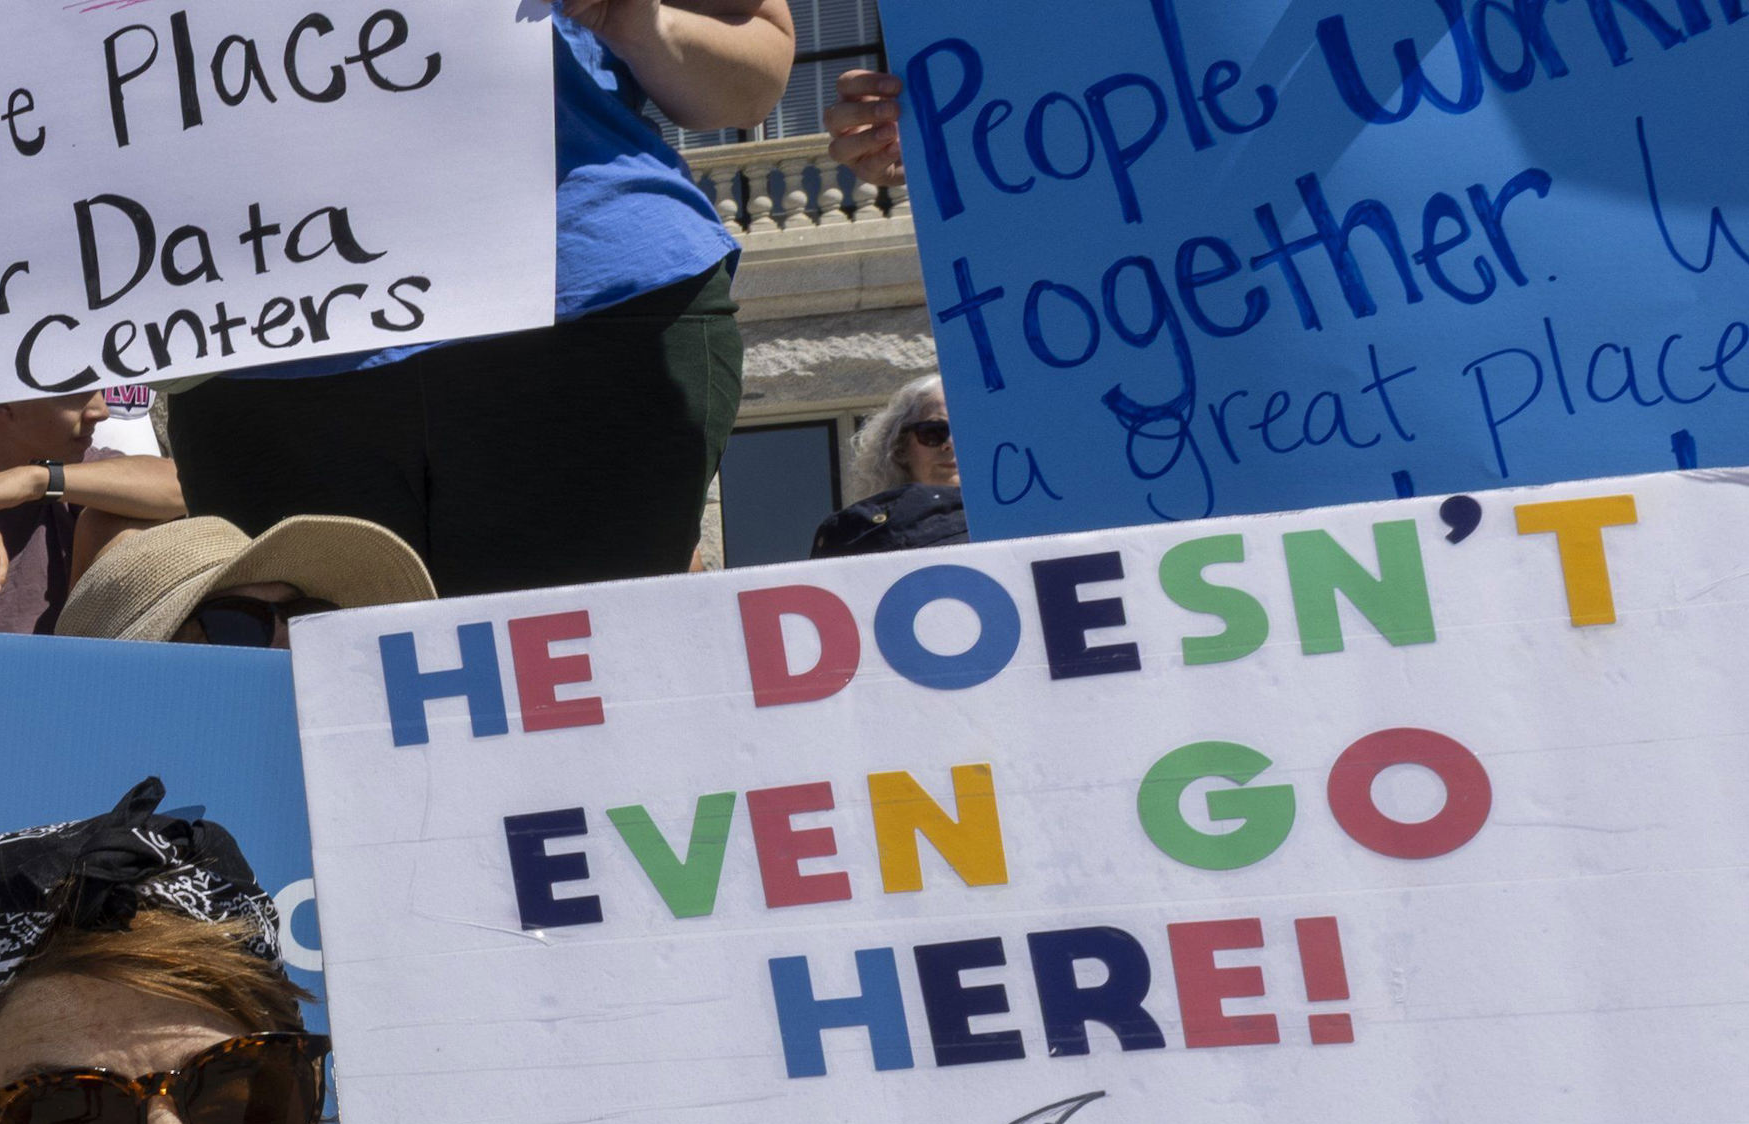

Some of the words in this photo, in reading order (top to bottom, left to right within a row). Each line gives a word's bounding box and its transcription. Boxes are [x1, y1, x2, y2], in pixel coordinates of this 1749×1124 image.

[101, 8, 442, 150] Place
[905, 0, 1280, 225] People
[73, 192, 388, 312] Data
[936, 167, 1560, 440] together.
[990, 441, 1063, 507] a
[1123, 343, 1421, 523] great
[1462, 315, 1749, 480] place
[376, 607, 606, 750] HE
[502, 759, 1011, 934] EVEN
[1135, 724, 1495, 873] GO
[767, 913, 1358, 1081] HERE!
